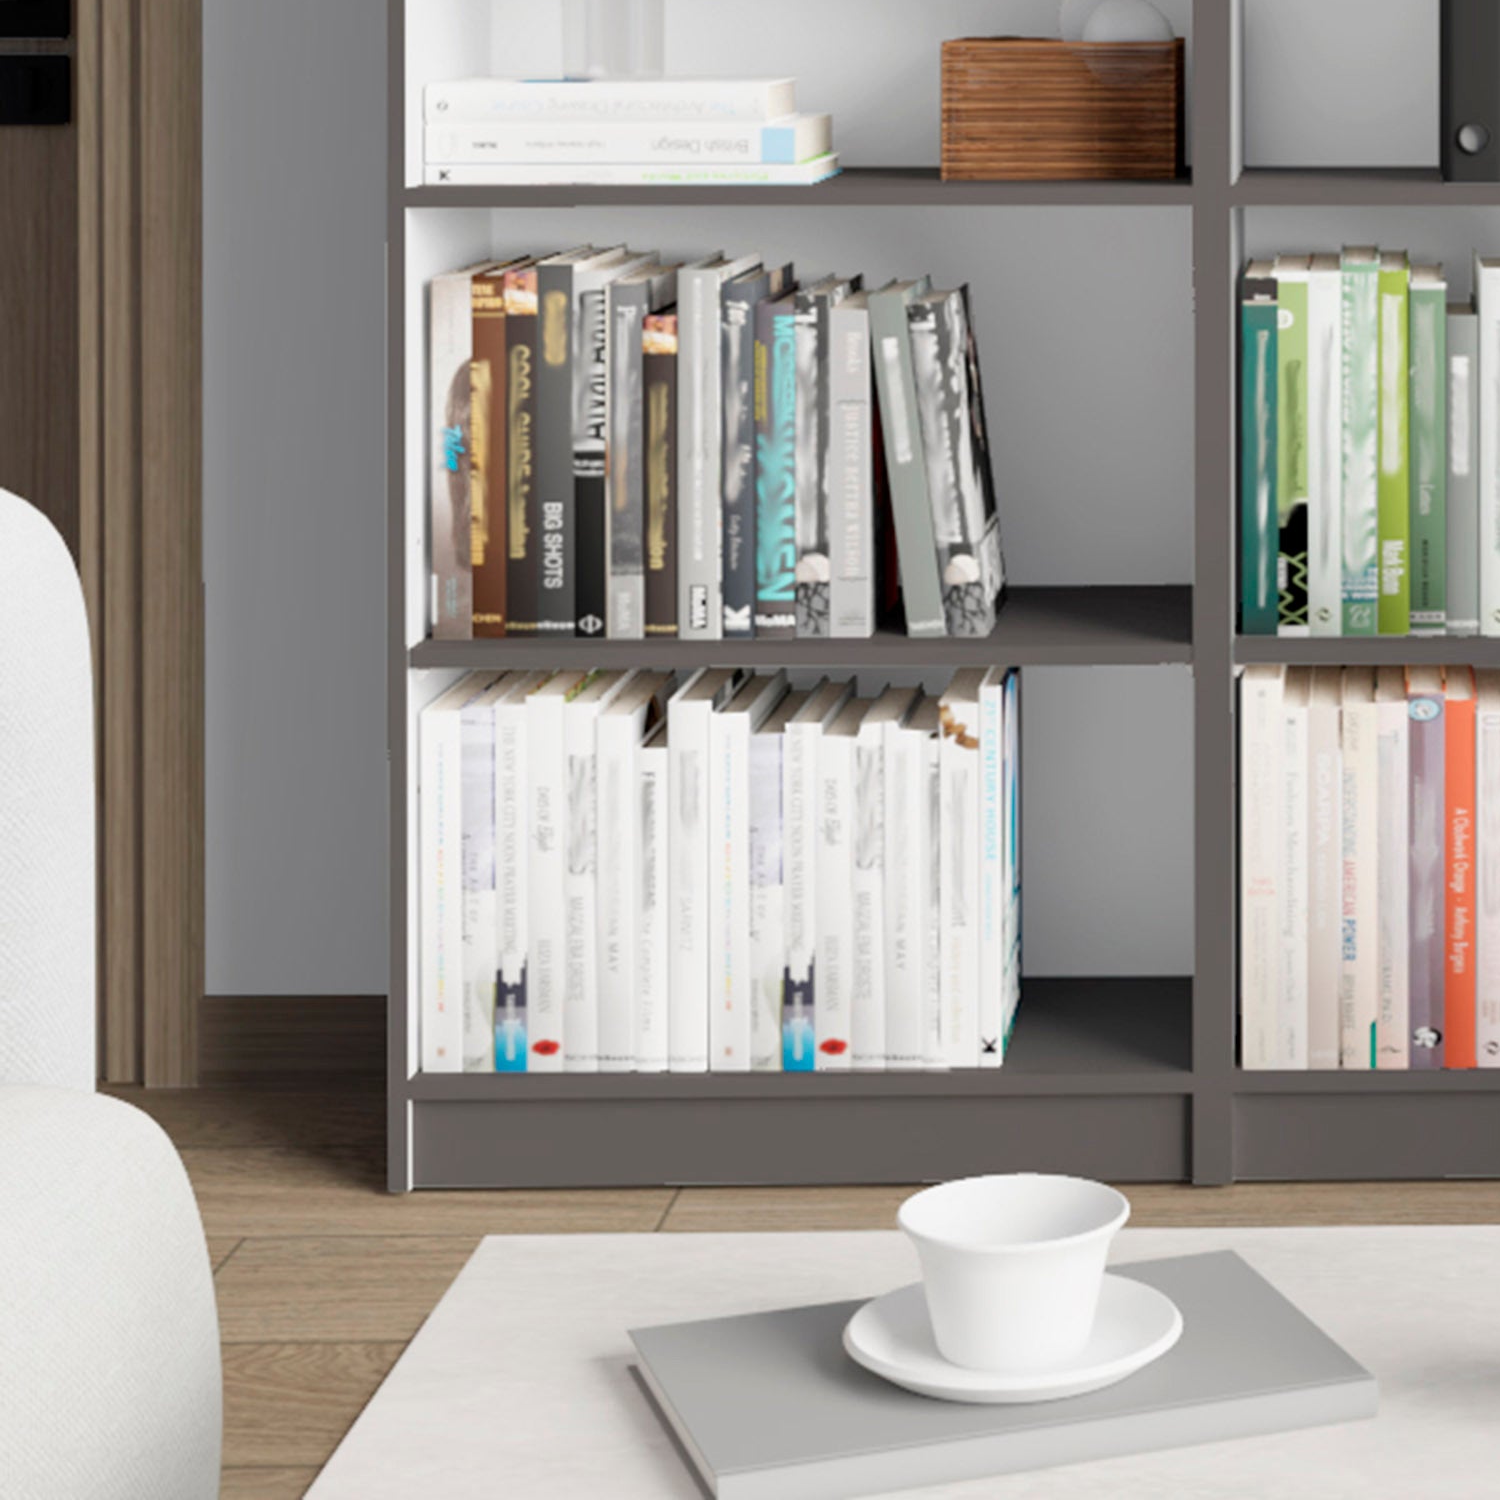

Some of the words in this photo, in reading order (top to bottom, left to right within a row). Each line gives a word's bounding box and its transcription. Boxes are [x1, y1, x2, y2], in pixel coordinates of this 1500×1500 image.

[650, 137, 701, 155] Design
[704, 139, 749, 155] British
[544, 502, 564, 531] BIG
[544, 533, 564, 589] SHOTS
[1382, 539, 1405, 565] Mark
[1382, 567, 1405, 596] Bunn
[984, 728, 997, 802] CENTURY
[1288, 771, 1303, 826] Fashion
[1342, 767, 1358, 857] UNDERSTANDING
[502, 805, 517, 831] CITY
[984, 808, 997, 861] HOUSE
[1284, 831, 1303, 938] Merchandising
[1342, 859, 1358, 917] AMERICAN
[1449, 861, 1470, 894] Orange
[607, 941, 619, 973] MAY
[1342, 918, 1358, 961] POWER
